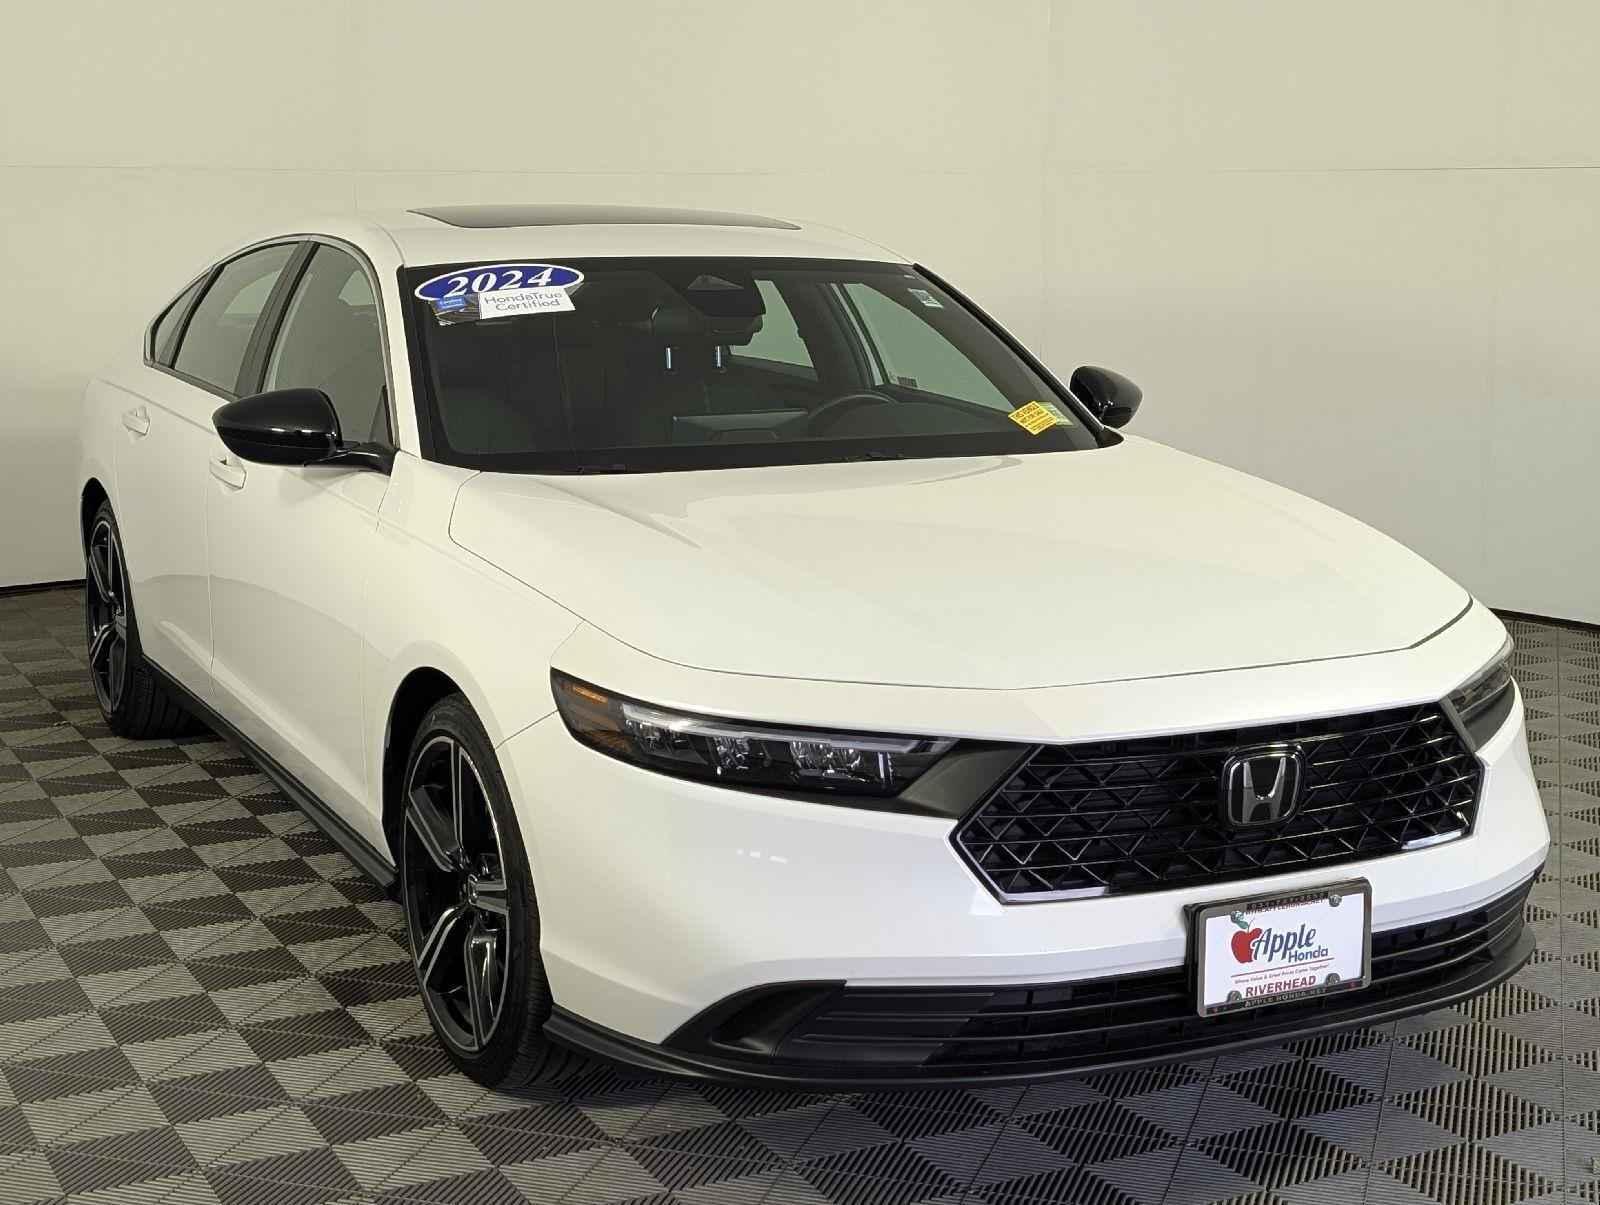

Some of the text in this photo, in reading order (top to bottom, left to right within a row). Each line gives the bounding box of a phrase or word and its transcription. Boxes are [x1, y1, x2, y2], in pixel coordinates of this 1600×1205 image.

[443, 267, 553, 298] 2024
[484, 292, 562, 304] HondaTrue
[496, 299, 560, 310] Certified
[1252, 923, 1316, 962] Apple
[1288, 945, 1328, 963] Honda
[1245, 975, 1316, 997] RIVERHEAD
[1245, 996, 1274, 1007] APPLE
